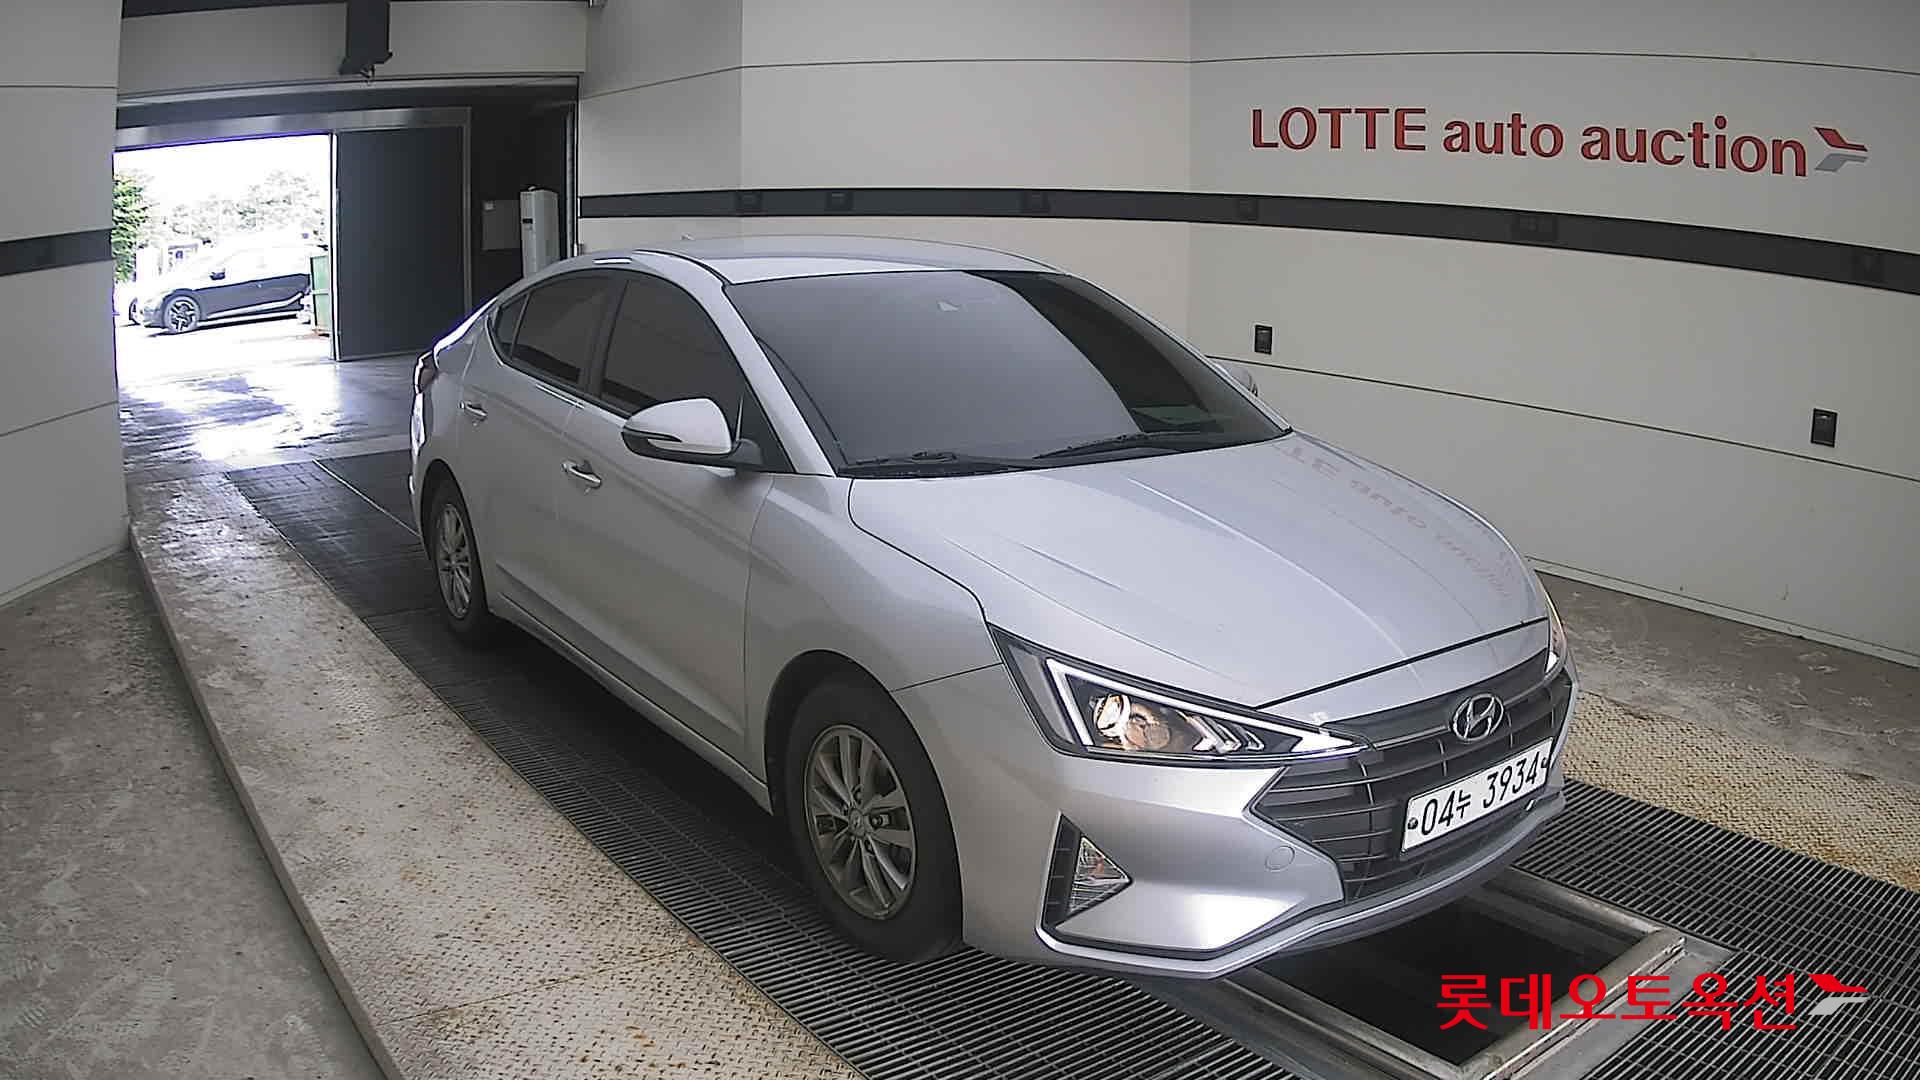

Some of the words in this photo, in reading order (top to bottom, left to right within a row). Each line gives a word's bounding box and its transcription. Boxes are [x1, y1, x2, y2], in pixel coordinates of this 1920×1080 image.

[1252, 107, 1426, 151] LOTTE
[1443, 113, 1565, 158] auto
[1580, 115, 1808, 176] auction
[1421, 790, 1471, 836] 04누
[1483, 752, 1540, 808] 3934
